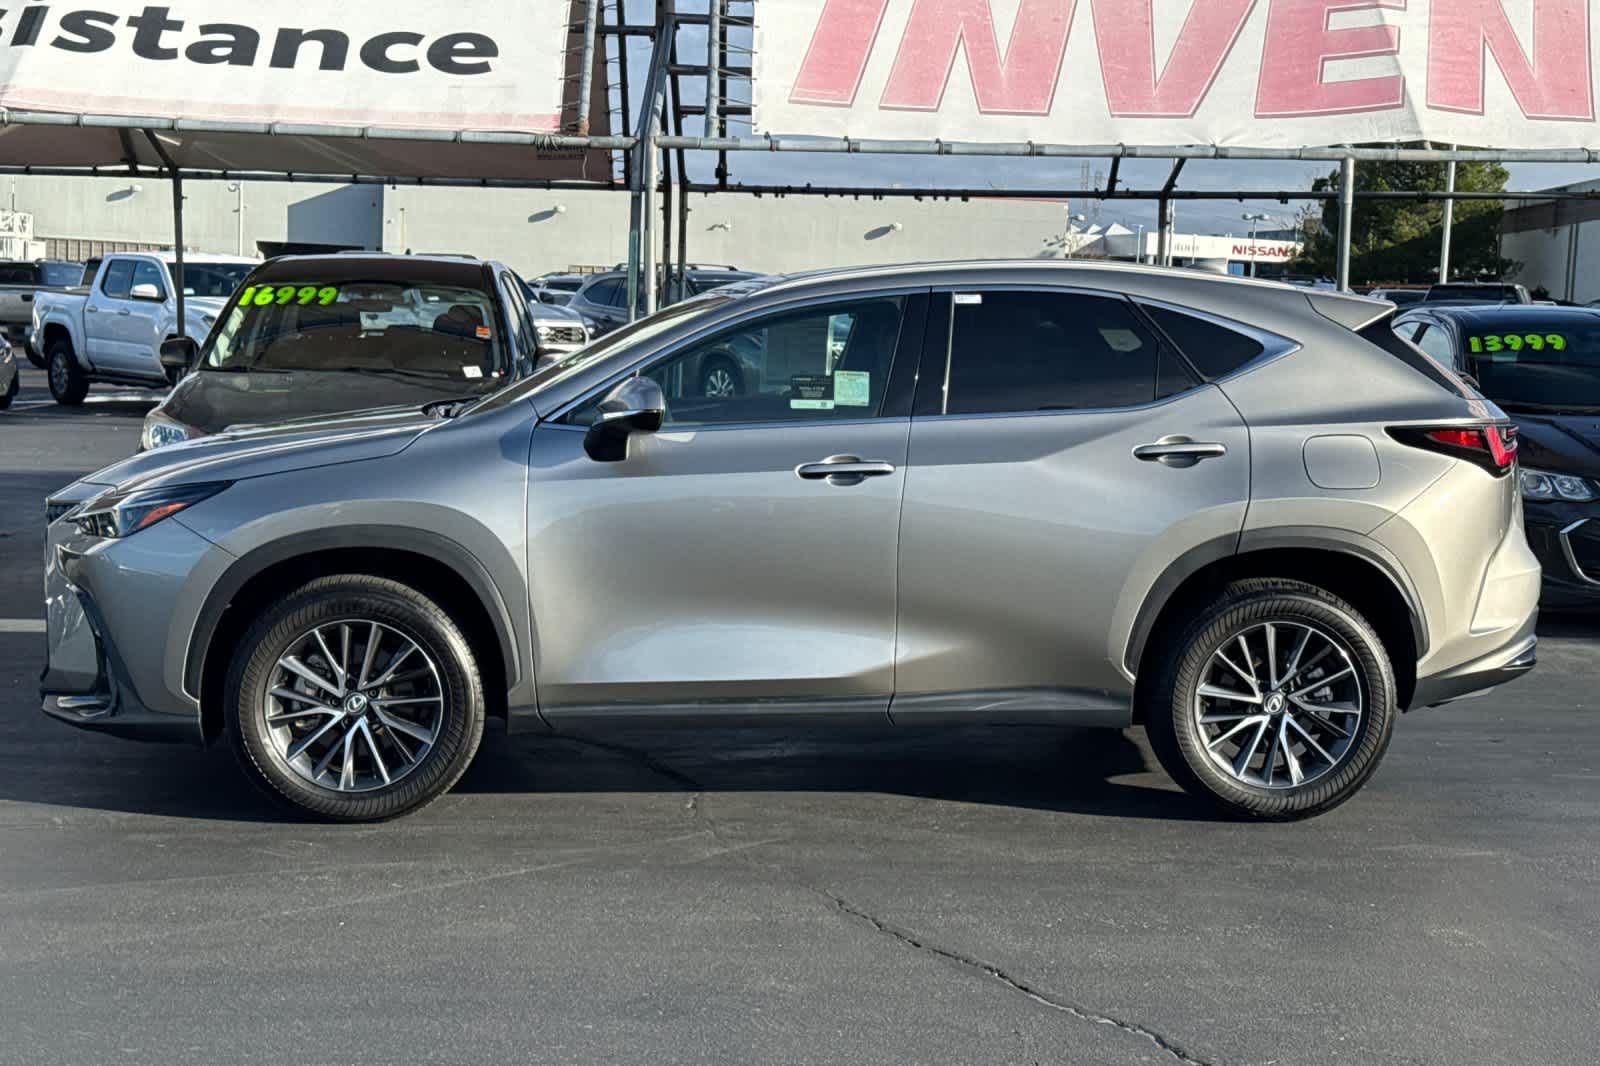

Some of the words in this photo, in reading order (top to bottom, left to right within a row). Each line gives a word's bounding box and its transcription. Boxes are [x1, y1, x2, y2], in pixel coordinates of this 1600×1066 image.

[0, 0, 499, 75] istance
[789, 0, 1595, 122] INVEN
[1232, 244, 1289, 257] NISSAN
[239, 286, 338, 306] 16999
[1469, 334, 1567, 353] 13999
